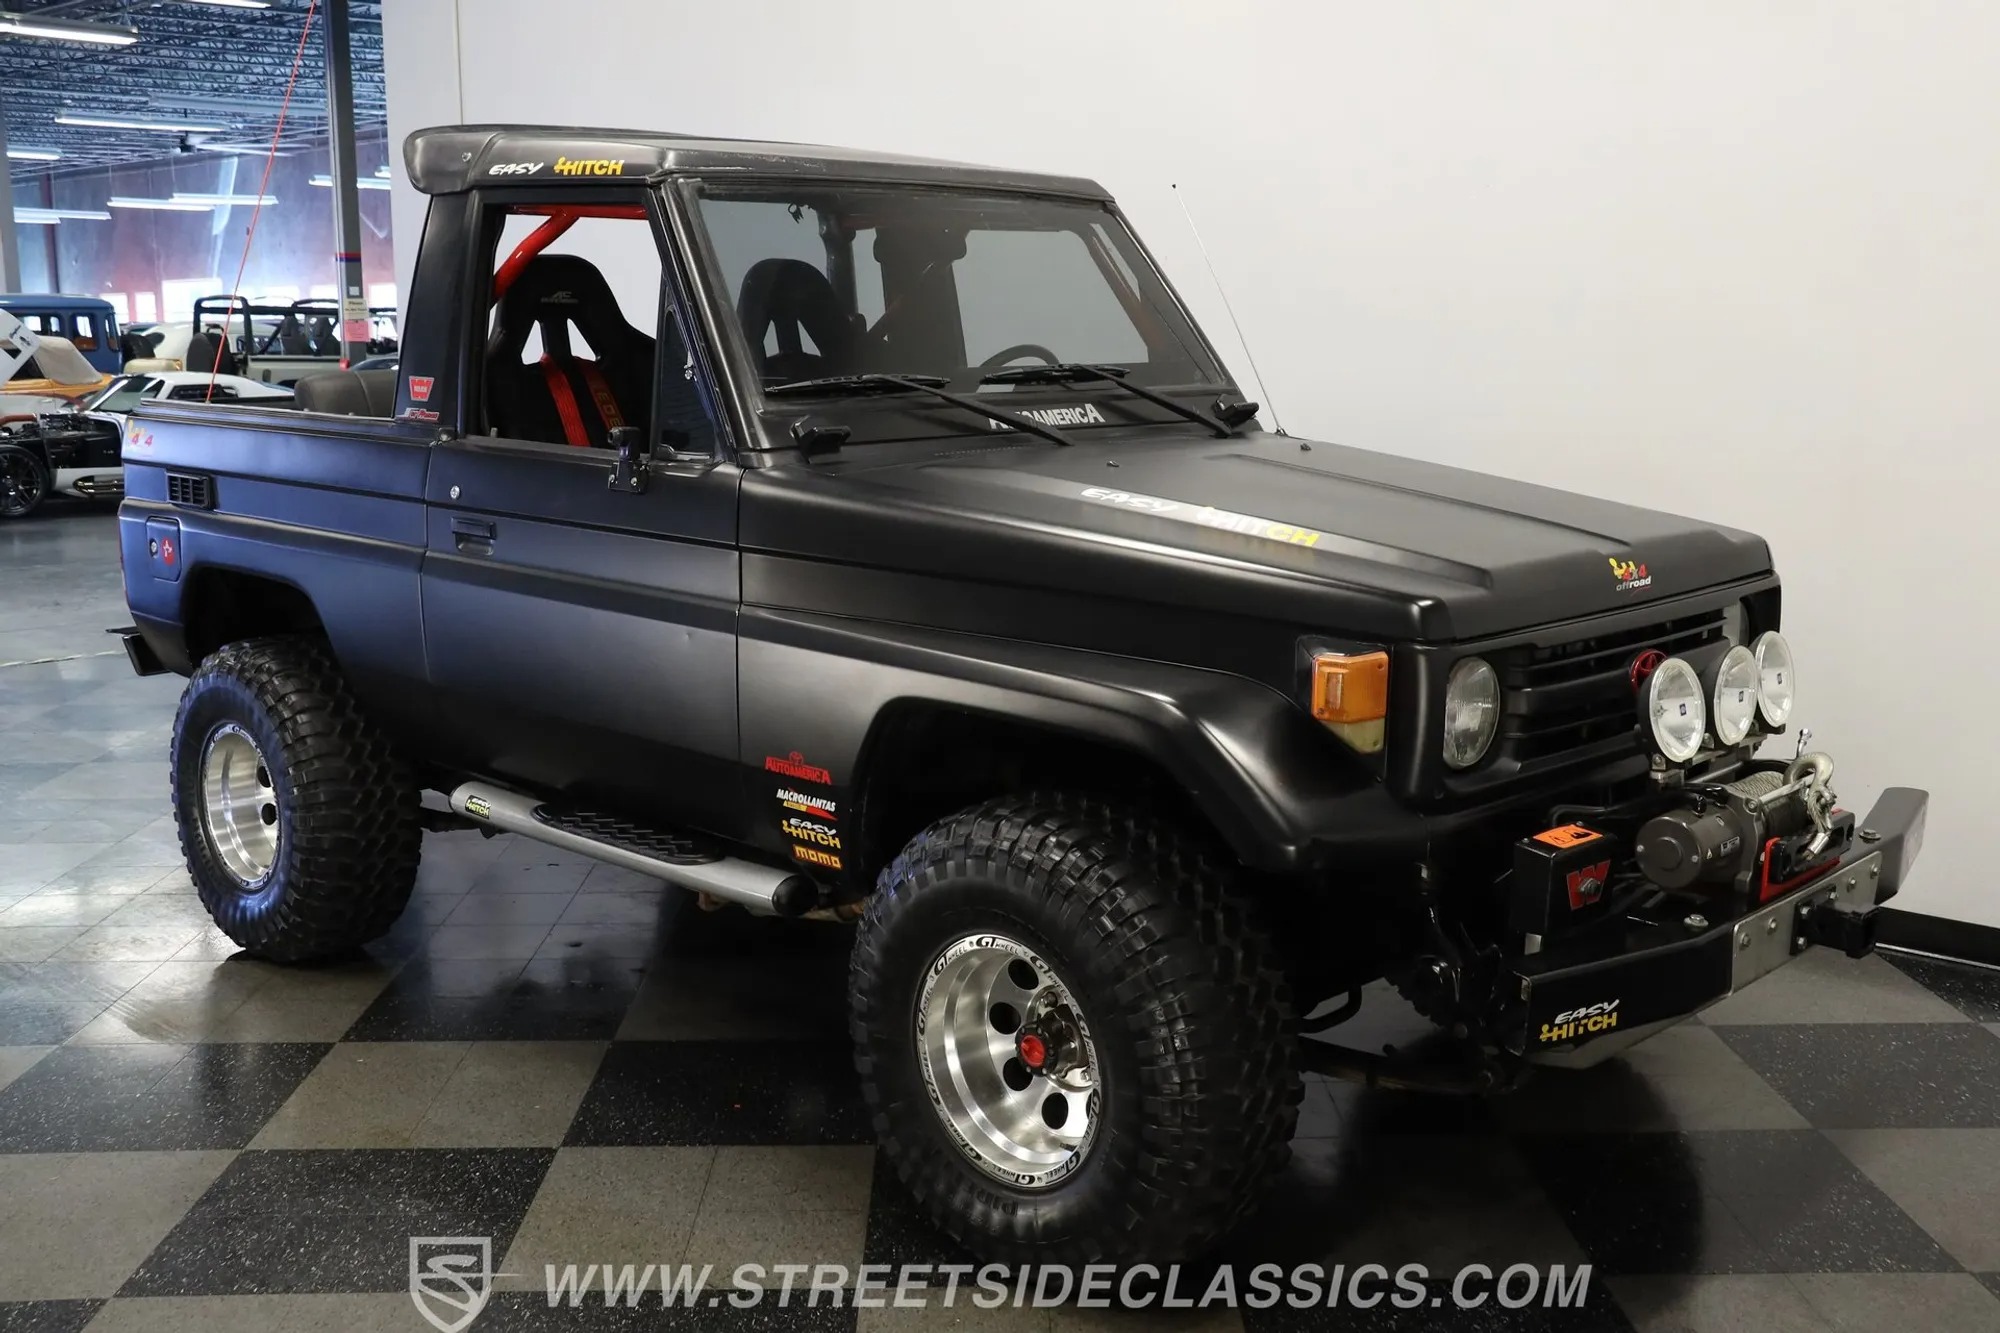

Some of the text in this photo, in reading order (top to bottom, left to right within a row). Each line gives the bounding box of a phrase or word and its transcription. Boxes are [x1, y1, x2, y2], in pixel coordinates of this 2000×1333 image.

[488, 159, 625, 176] EASY HITCH
[1080, 487, 1180, 513] EASY
[776, 788, 836, 812] MACROLLANTAS
[790, 825, 841, 849] HITCH
[1554, 999, 1620, 1025] EASY
[1550, 1012, 1618, 1042] HITCH
